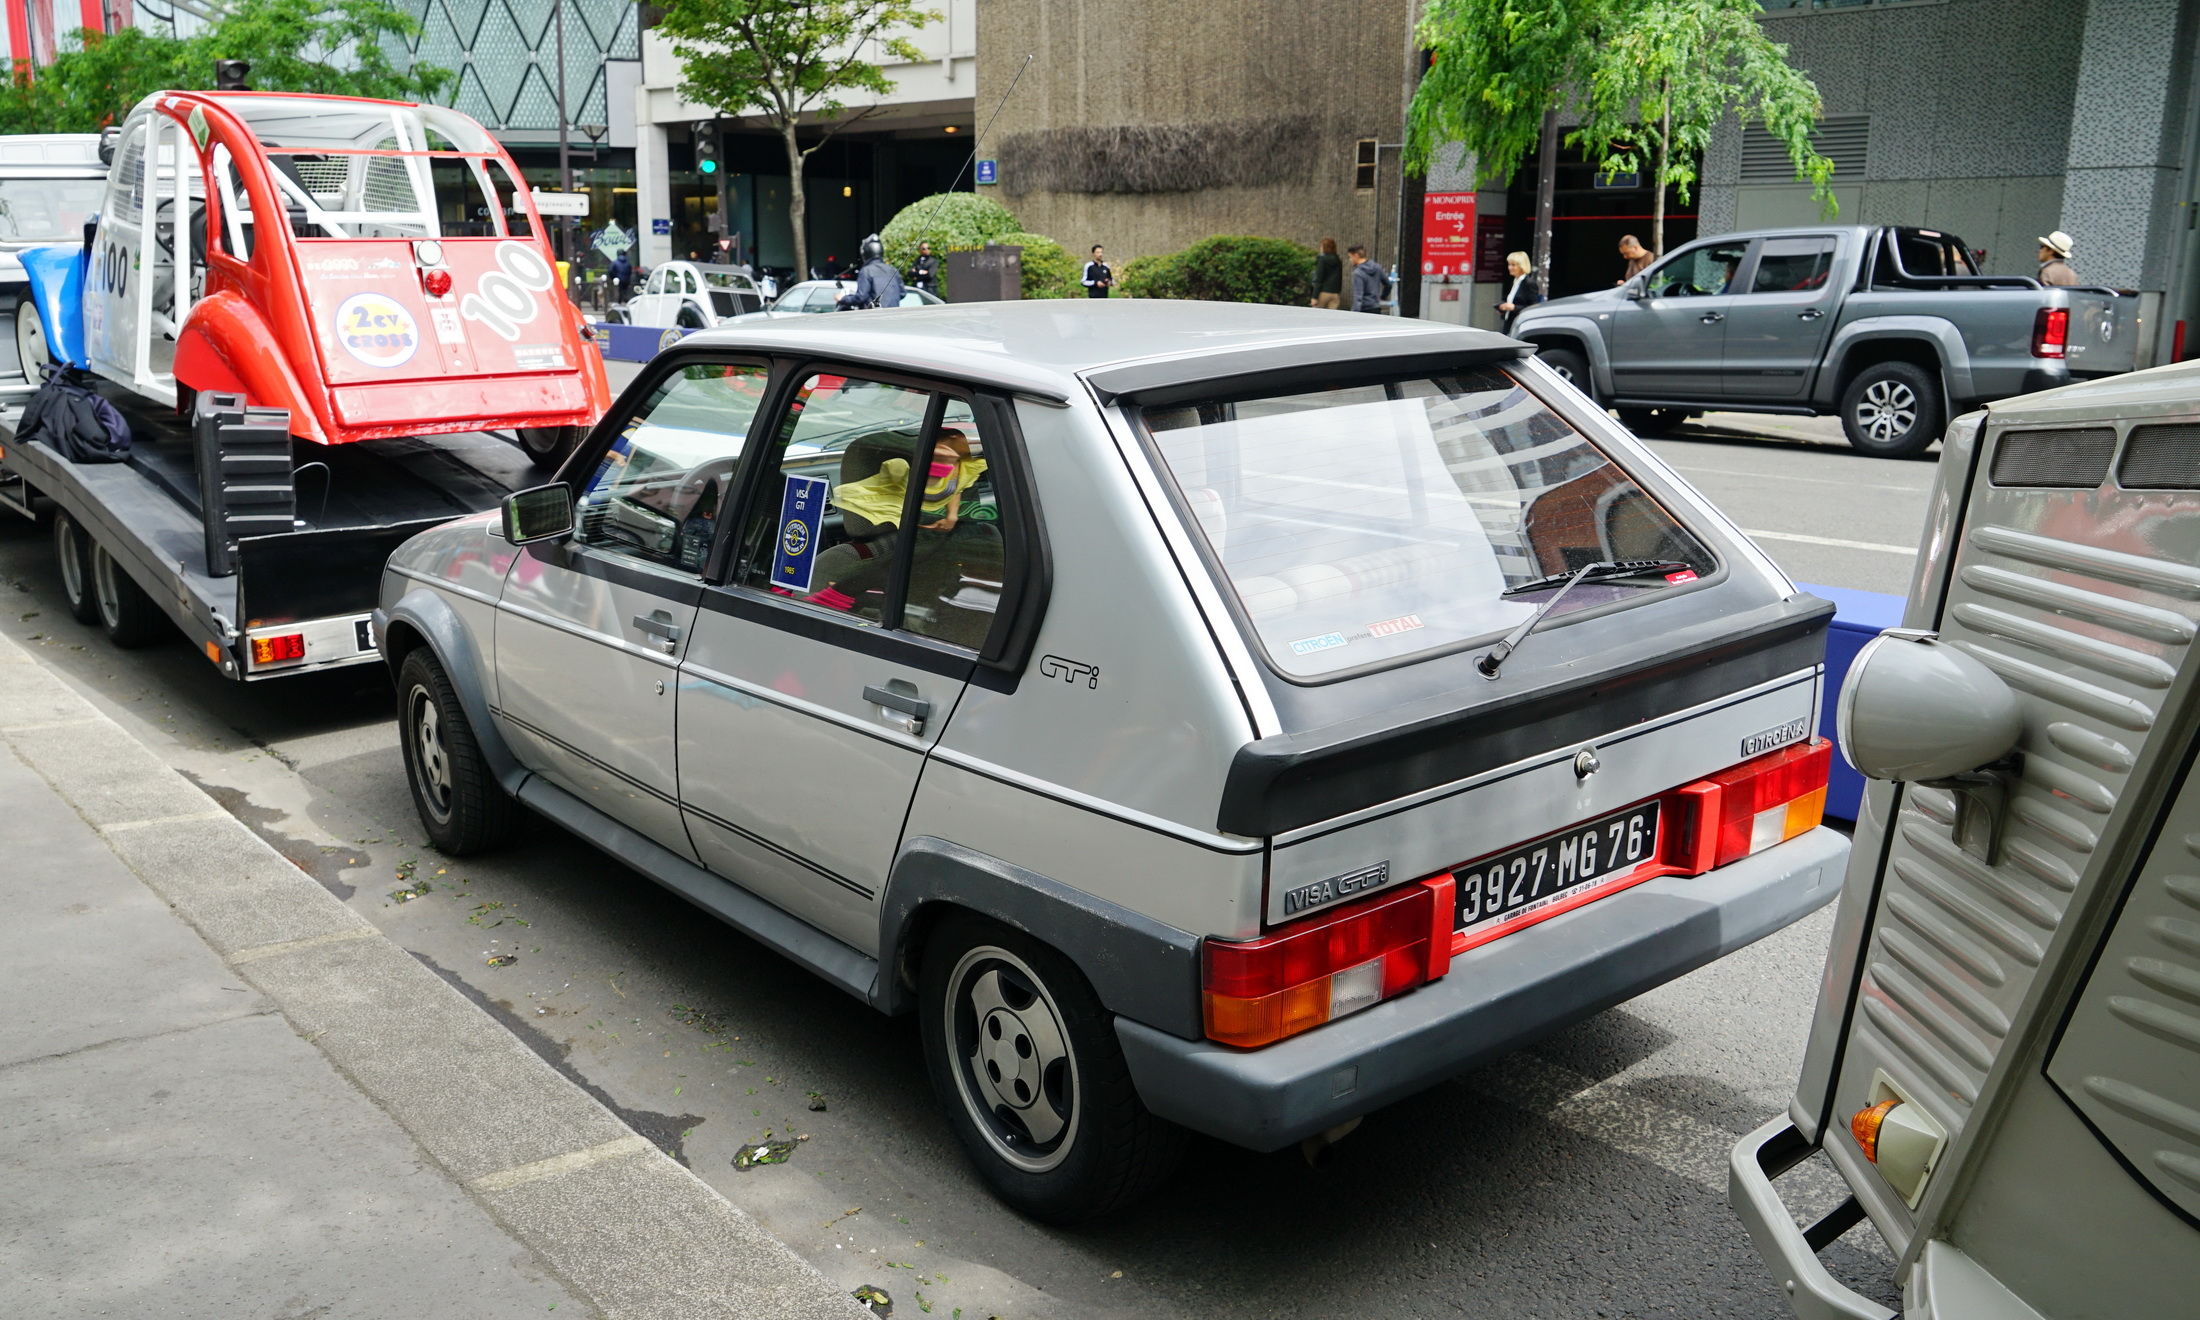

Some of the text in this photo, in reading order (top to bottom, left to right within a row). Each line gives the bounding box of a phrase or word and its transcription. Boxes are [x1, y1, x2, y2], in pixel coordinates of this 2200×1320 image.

[1433, 195, 1475, 204] MONOPRIX
[1436, 211, 1465, 220] Entrée
[102, 241, 128, 298] 100
[461, 240, 554, 342] 100
[347, 333, 413, 348] CROSS
[796, 489, 809, 499] VISA
[795, 501, 805, 510] GTI
[785, 566, 795, 574] 1985
[1293, 634, 1344, 653] CITROËN
[1368, 616, 1424, 637] TOTAL
[1746, 723, 1796, 755] CITROËN
[1463, 815, 1644, 924] 3927 MG 76
[1291, 882, 1333, 910] VISA
